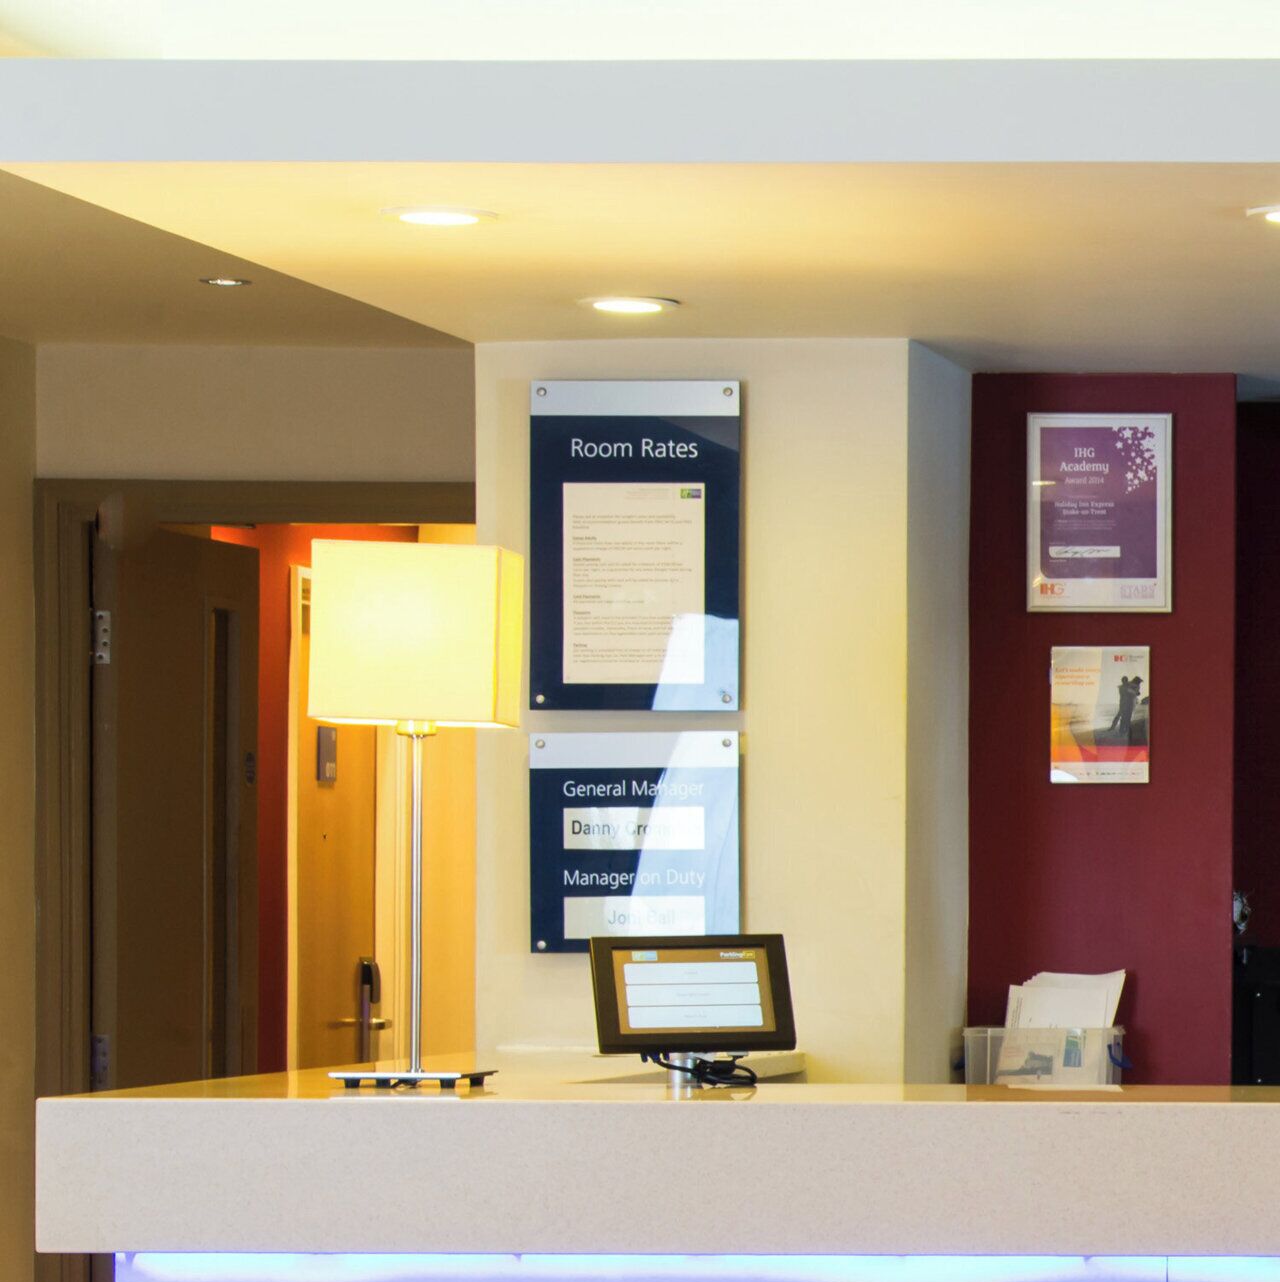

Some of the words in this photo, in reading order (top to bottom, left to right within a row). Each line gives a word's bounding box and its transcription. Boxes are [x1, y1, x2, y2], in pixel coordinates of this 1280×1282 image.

[570, 438, 633, 459] Room
[641, 438, 699, 459] Rates
[1074, 447, 1095, 458] IHG
[1060, 460, 1109, 475] Academy
[562, 780, 626, 797] General
[632, 780, 705, 800] Manager
[571, 819, 620, 839] Danny
[563, 869, 635, 890] Manager
[640, 872, 660, 885] on
[666, 868, 706, 889] Duty
